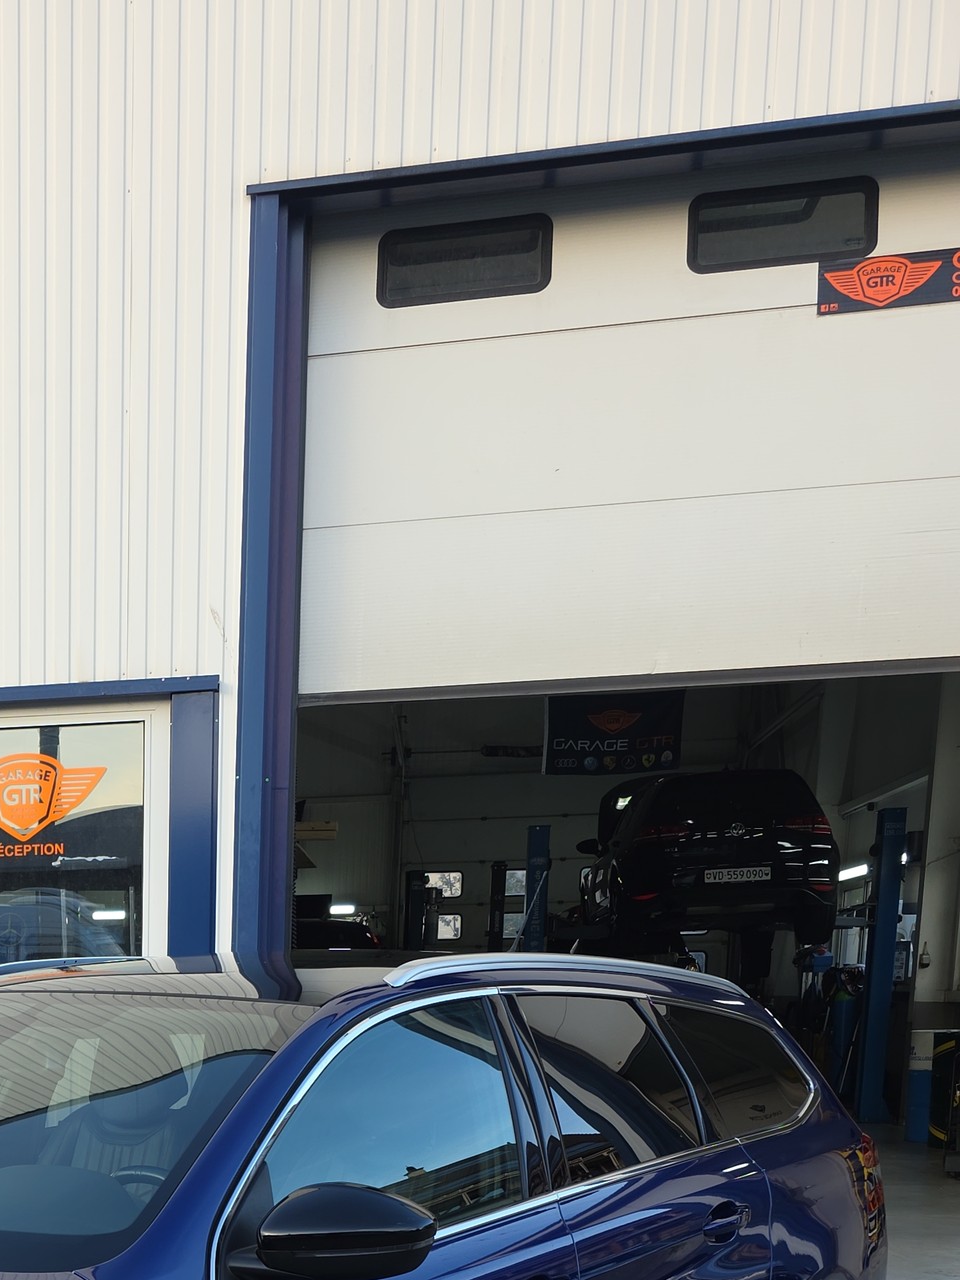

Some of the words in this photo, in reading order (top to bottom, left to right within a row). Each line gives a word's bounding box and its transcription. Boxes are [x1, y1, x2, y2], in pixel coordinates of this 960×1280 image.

[861, 265, 903, 277] GARAGE
[866, 274, 897, 289] GTR
[553, 738, 629, 751] GARAGE
[636, 736, 673, 749] GTR
[2, 783, 44, 806] GTR
